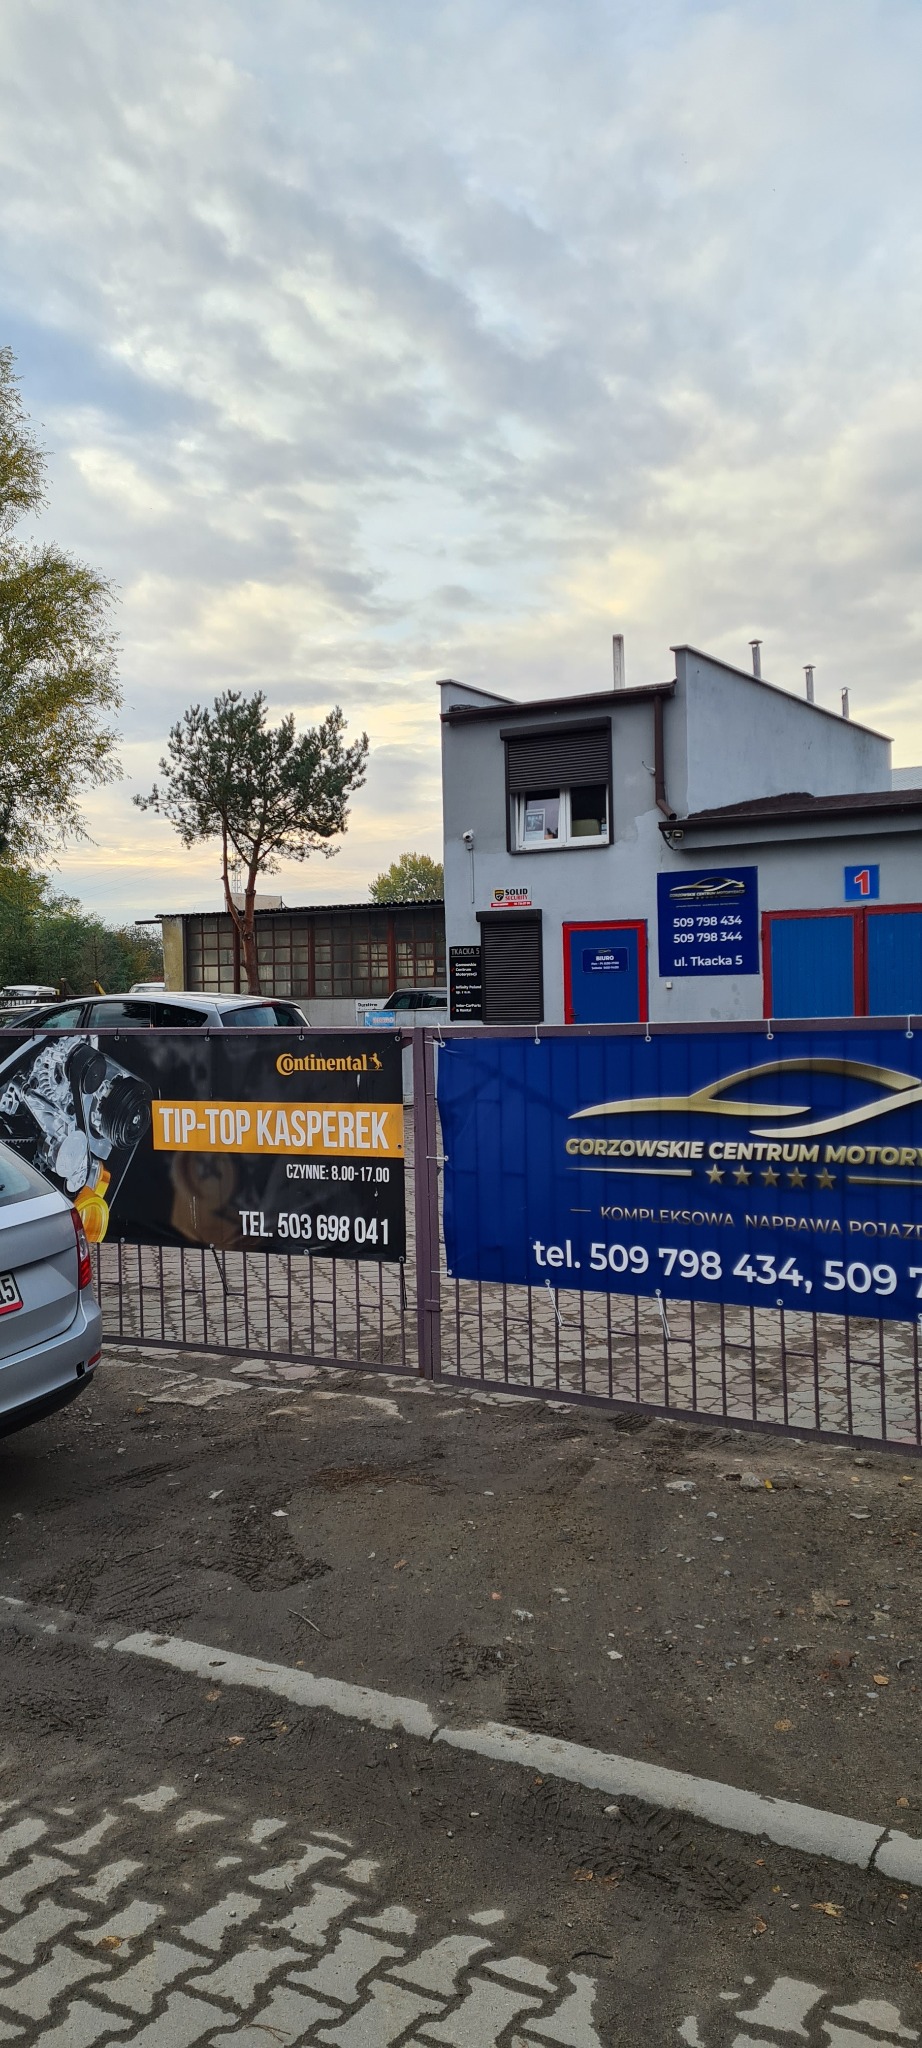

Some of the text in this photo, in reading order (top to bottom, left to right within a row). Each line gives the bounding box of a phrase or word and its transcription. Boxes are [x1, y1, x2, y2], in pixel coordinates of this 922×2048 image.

[854, 870, 870, 895] 1
[673, 915, 743, 928] 509 798 434
[673, 931, 743, 944] 509 798 344
[674, 955, 743, 967] ul. Tkacka 5
[276, 1053, 368, 1076] Continental
[159, 1107, 390, 1150] TIP-TOP KASPEREK
[565, 1138, 704, 1159] GORZOWSKIE
[708, 1141, 820, 1163] CENTRUM
[286, 1163, 390, 1183] CZYNNE: 8.00-17.00
[238, 1210, 389, 1245] TEL. 503 698 041
[600, 1206, 735, 1228] KOMPLEKSOWA
[744, 1214, 843, 1235] NAPRAWA
[532, 1239, 581, 1269] tel.
[589, 1242, 649, 1274] 509
[658, 1247, 723, 1281] 798
[732, 1253, 813, 1295] 434,
[823, 1260, 898, 1296] 509
